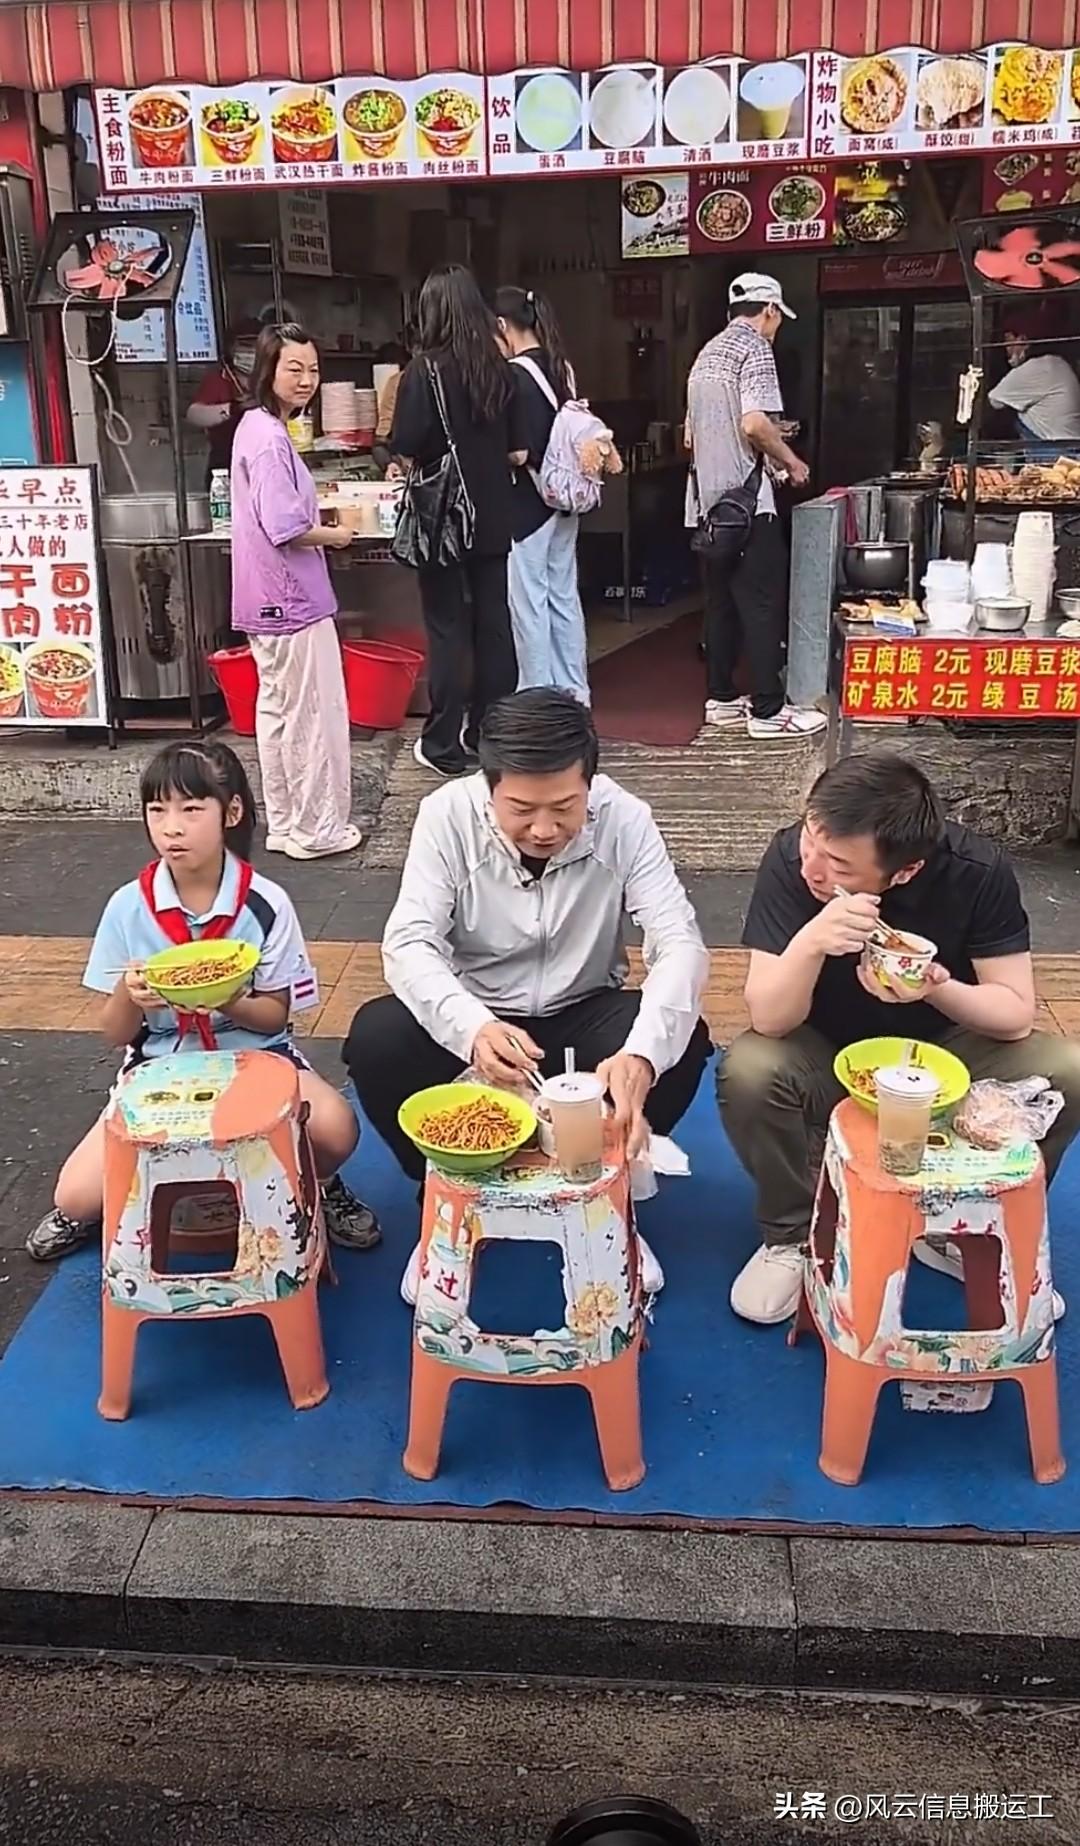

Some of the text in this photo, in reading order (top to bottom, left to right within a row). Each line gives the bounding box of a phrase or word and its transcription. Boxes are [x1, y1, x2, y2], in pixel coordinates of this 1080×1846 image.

[815, 54, 838, 157] 炸物小吃
[492, 96, 512, 154] 饮品
[101, 94, 128, 186] 主食粉面
[603, 150, 646, 166] 豆腐脑
[683, 147, 712, 162] 清酒
[742, 142, 800, 159] 现磨豆浆
[353, 161, 408, 177] 炸酱粉面
[423, 159, 479, 175] 肉丝粉面
[538, 154, 566, 169] 蛋酒
[138, 169, 194, 184] 牛肉粉面
[210, 167, 265, 182] 三鲜粉面
[274, 163, 343, 180] 武汉热干面
[768, 224, 822, 241] 三鲜粉
[0, 535, 67, 558] 人做的
[1, 602, 93, 637] 肉粉
[850, 647, 1080, 676] 豆腐脑 2元 现磨豆浆
[847, 680, 1078, 711] 矿泉水 2元 绿豆汤
